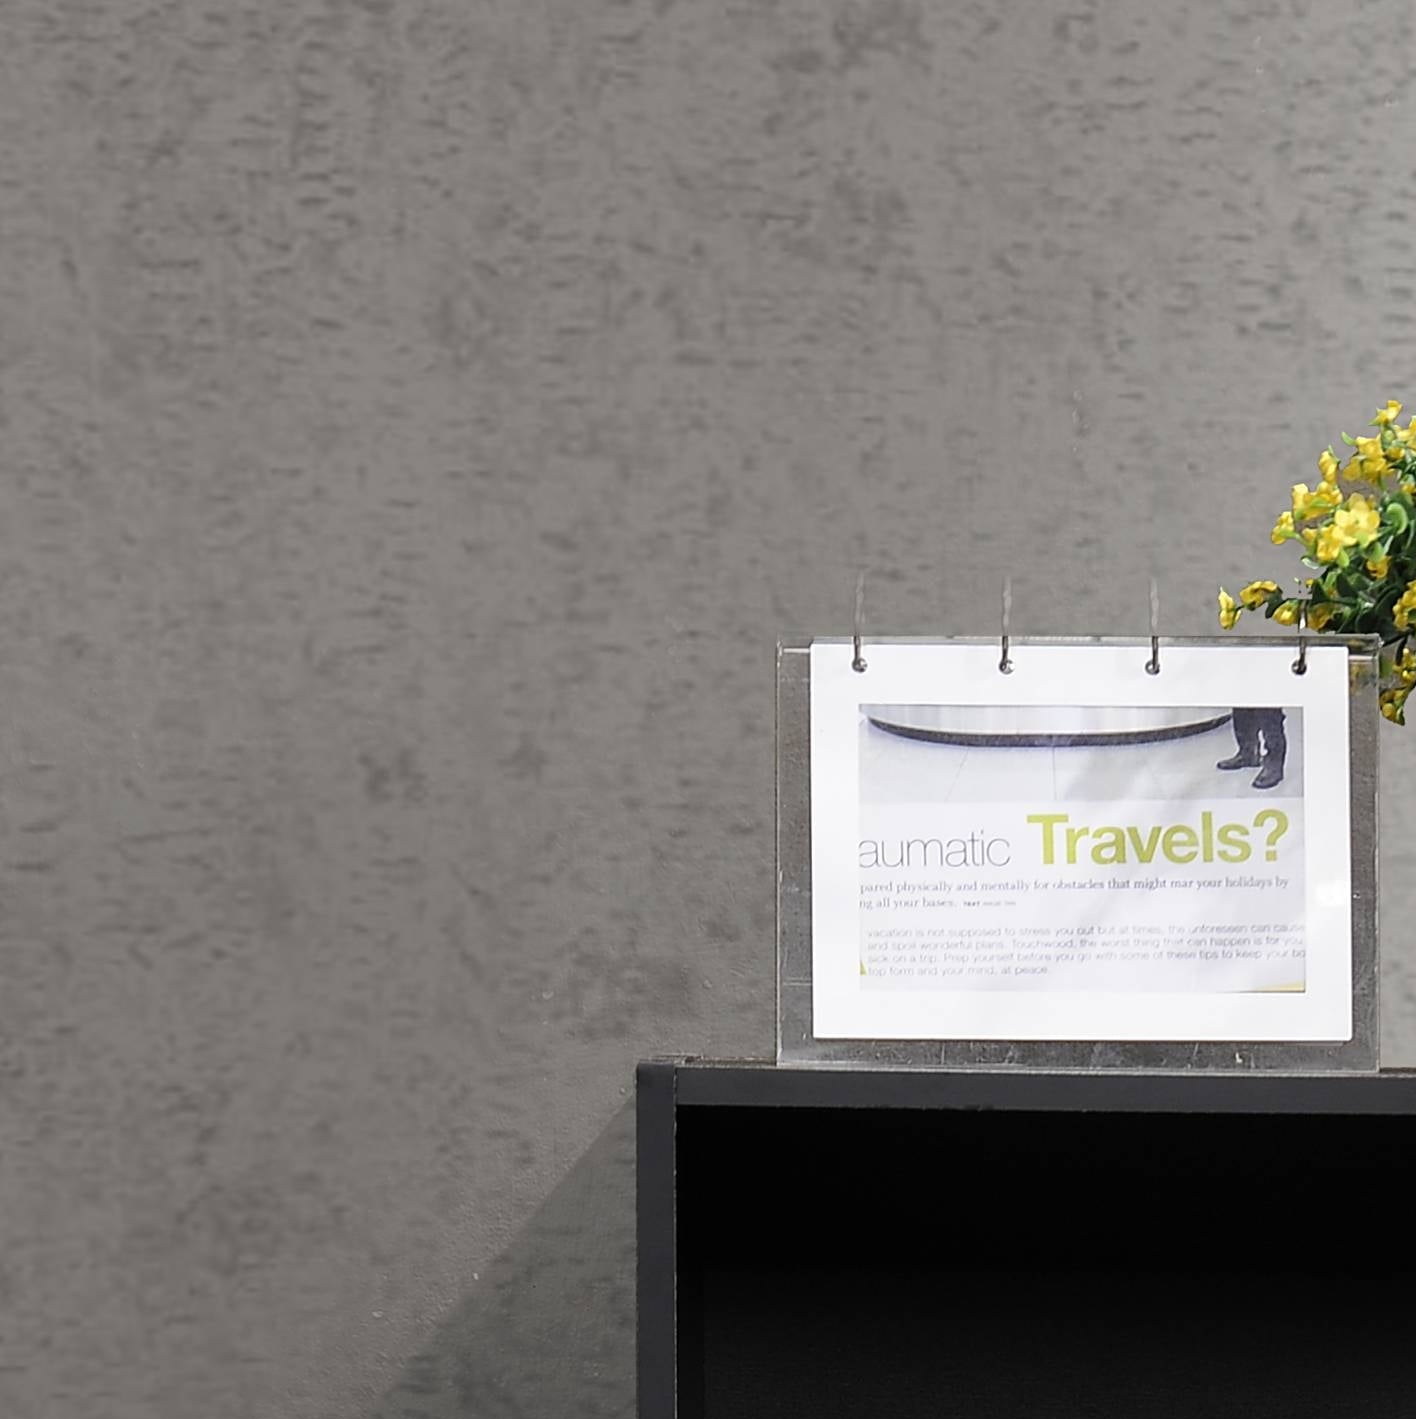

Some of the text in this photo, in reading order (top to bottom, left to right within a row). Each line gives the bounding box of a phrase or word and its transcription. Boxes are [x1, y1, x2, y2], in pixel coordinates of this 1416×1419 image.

[858, 809, 1289, 868] aumatic Travels?
[896, 880, 953, 894] physically
[956, 880, 978, 891] and
[981, 880, 1030, 892] mentally
[1034, 880, 1049, 890] for
[1053, 878, 1104, 890] obstacles
[1108, 879, 1130, 889] that
[1134, 879, 1167, 891] might
[1170, 880, 1194, 888] mar
[1196, 879, 1222, 890] your
[1226, 877, 1272, 889] holidays
[1275, 876, 1288, 888] by
[876, 897, 890, 907] all
[893, 899, 919, 909] your
